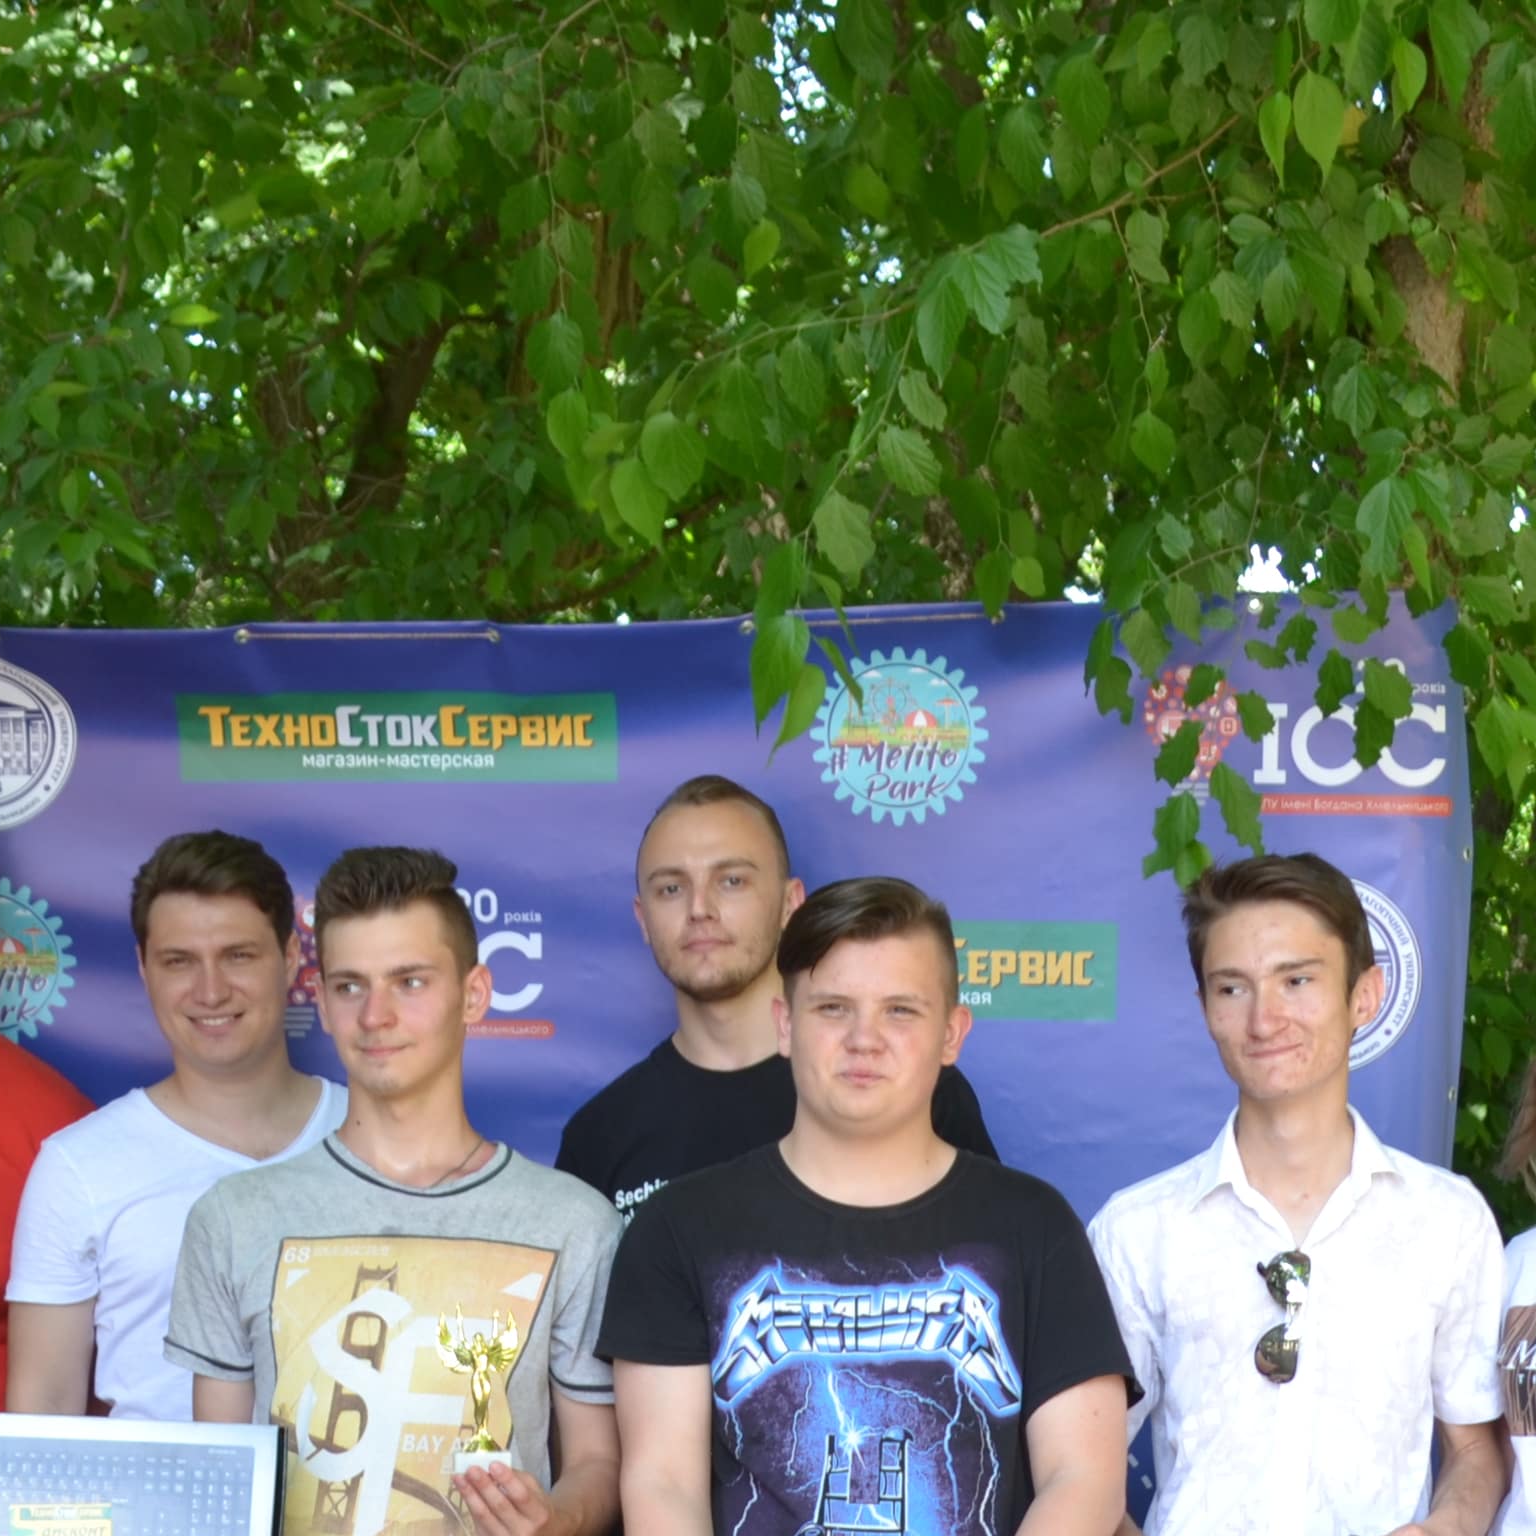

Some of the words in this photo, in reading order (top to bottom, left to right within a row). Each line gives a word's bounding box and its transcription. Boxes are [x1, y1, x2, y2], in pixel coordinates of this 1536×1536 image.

[302, 752, 495, 771] магазин-мастерская
[859, 740, 958, 773] Melito
[865, 772, 948, 800] Park
[714, 1271, 1021, 1411] METALLICA
[401, 1433, 447, 1454] BAY
